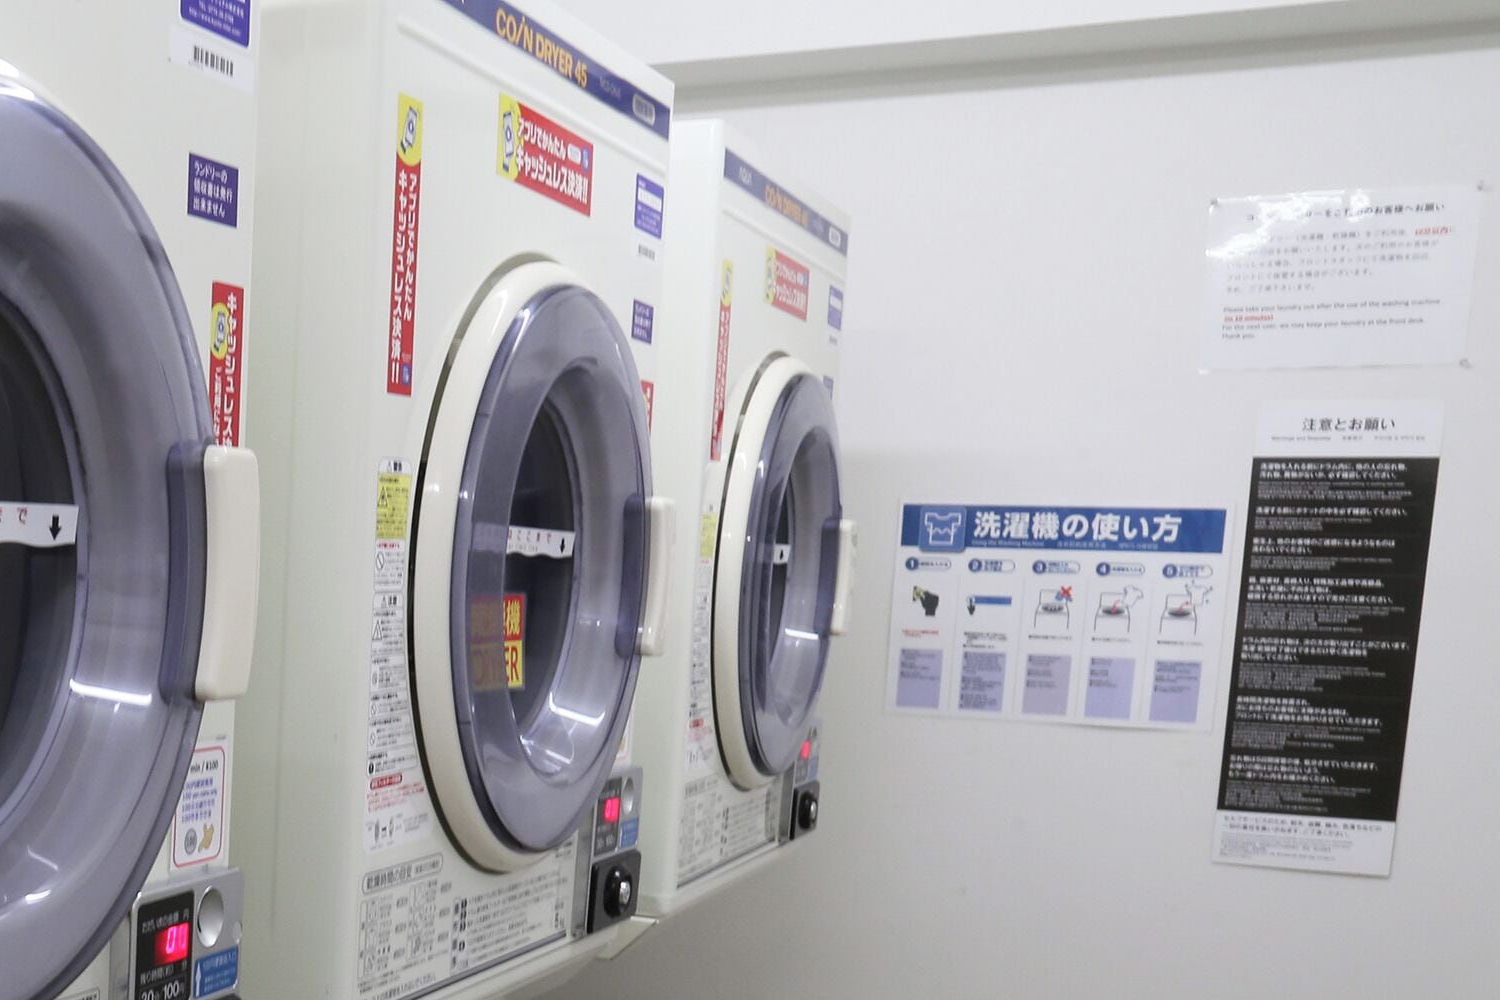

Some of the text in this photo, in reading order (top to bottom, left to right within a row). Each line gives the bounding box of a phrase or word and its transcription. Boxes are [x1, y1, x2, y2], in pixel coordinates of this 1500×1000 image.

[536, 36, 573, 79] DRYER
[575, 60, 589, 88] 45
[1302, 417, 1396, 432] 注意とお願い
[973, 511, 1183, 543] 洗濯機の使い方
